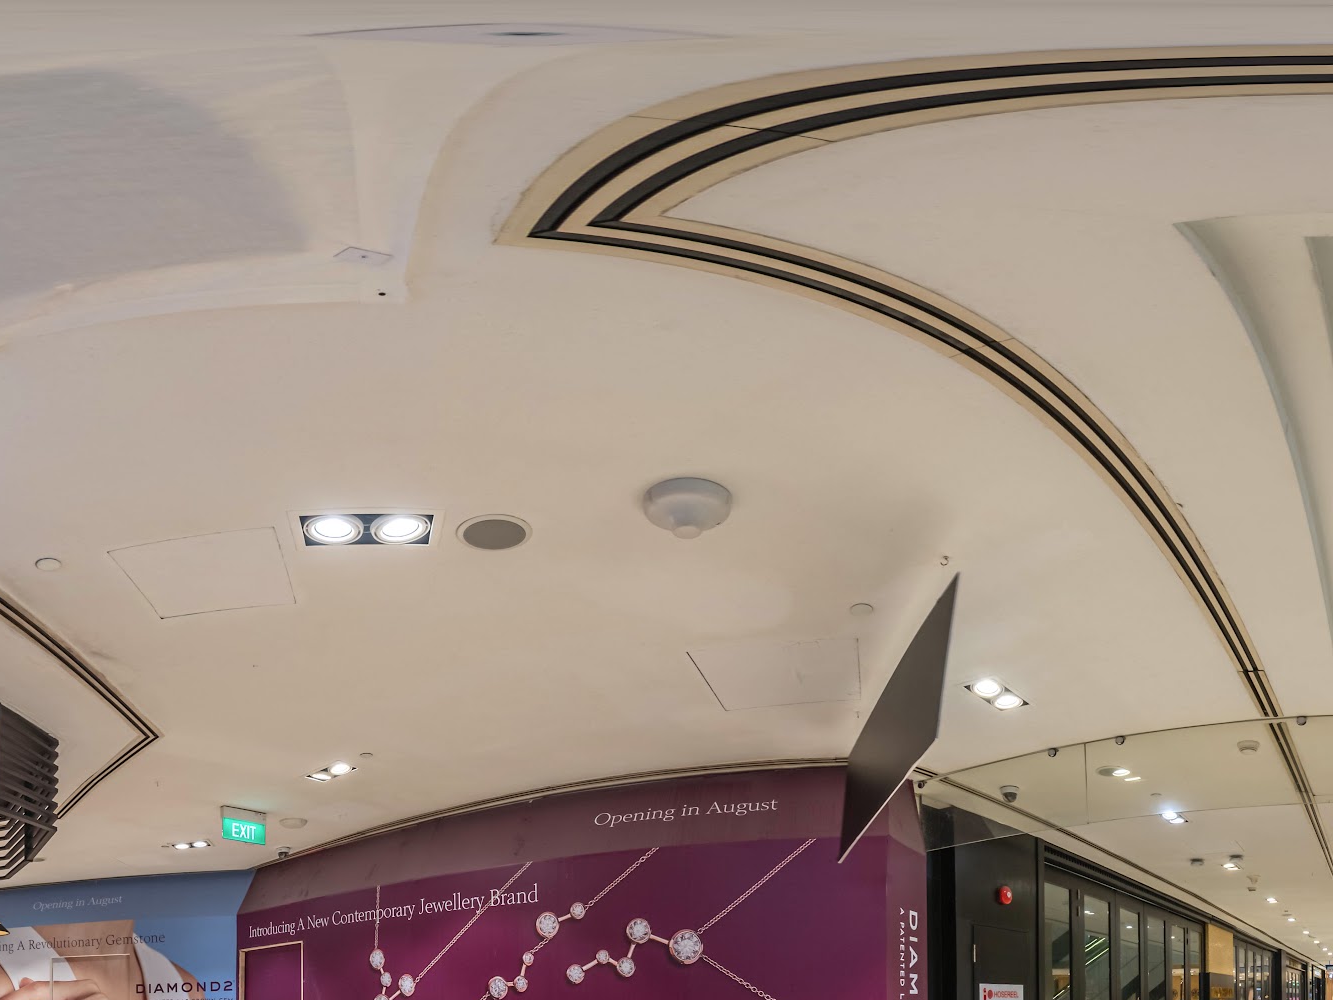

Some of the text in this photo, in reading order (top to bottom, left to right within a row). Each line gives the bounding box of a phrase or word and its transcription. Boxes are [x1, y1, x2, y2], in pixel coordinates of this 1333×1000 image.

[594, 798, 779, 827] Opening in August
[232, 823, 256, 840] EXIT
[33, 901, 73, 911] Opening
[87, 896, 122, 906] August
[249, 883, 539, 938] Introducing A New Contemporary Jewellery Brand
[899, 907, 905, 915] A
[17, 941, 26, 951] A
[29, 936, 103, 950] Revolutionary
[105, 933, 166, 946] Gemstone
